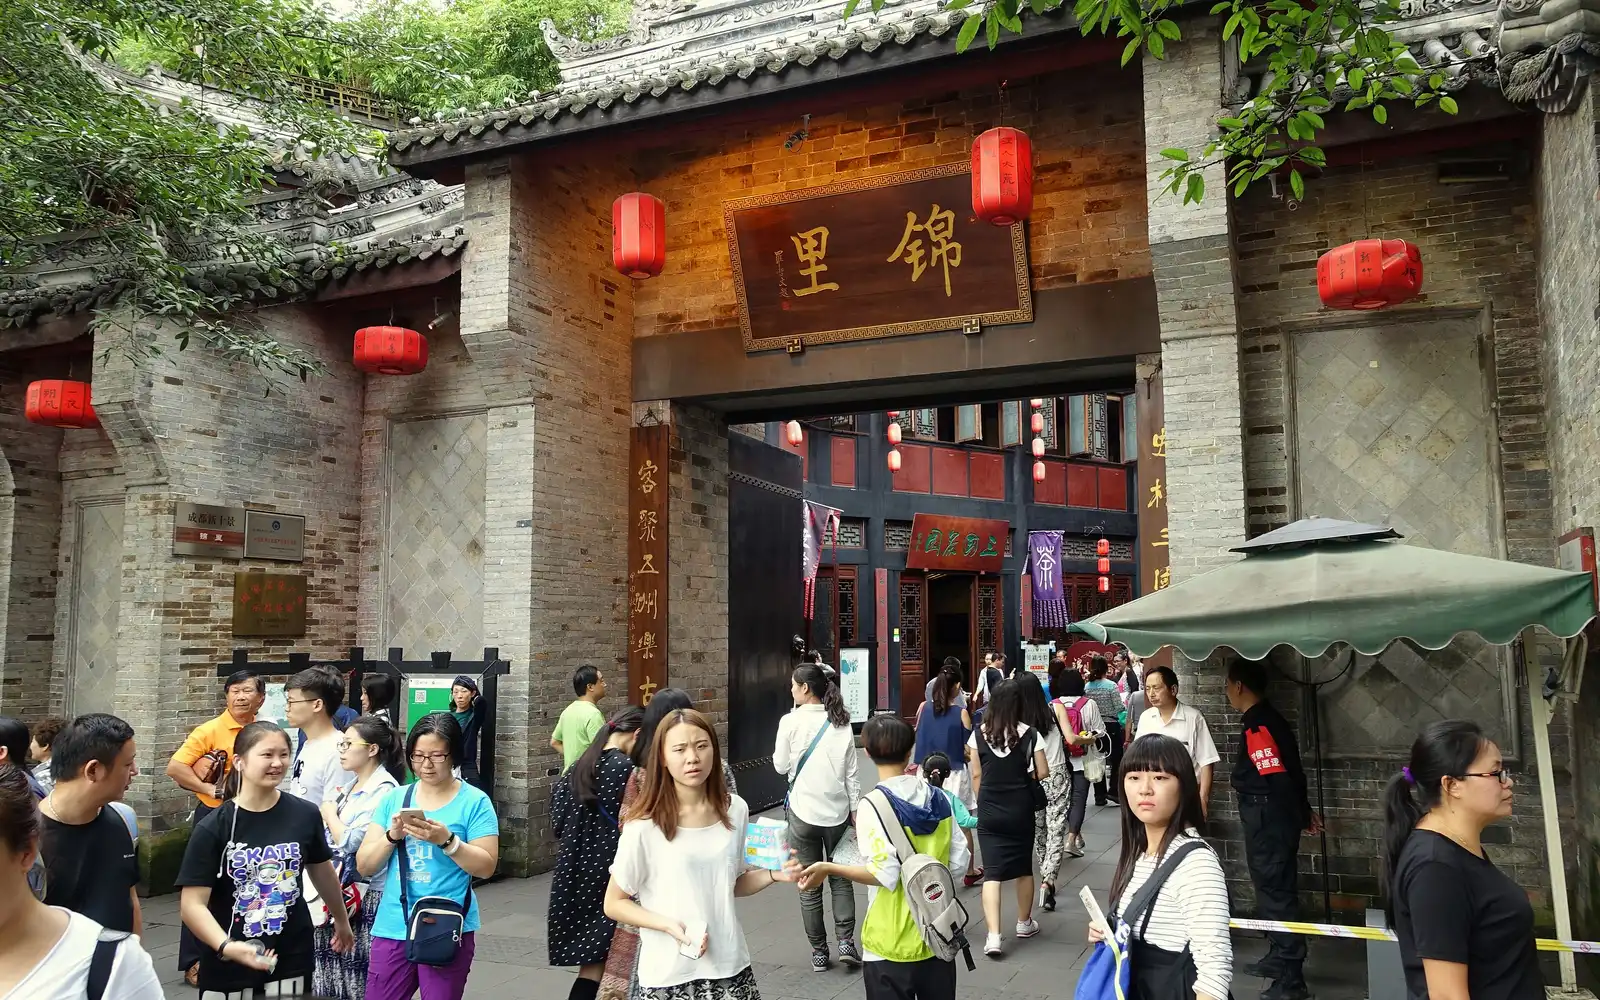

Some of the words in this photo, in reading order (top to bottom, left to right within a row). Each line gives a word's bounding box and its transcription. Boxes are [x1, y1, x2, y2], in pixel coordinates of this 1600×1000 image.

[787, 203, 963, 298] 锦里
[187, 511, 236, 527] 成都新十景
[1036, 545, 1056, 590] 茶
[231, 842, 302, 867] SKATE
[1246, 920, 1274, 930] POLICE
